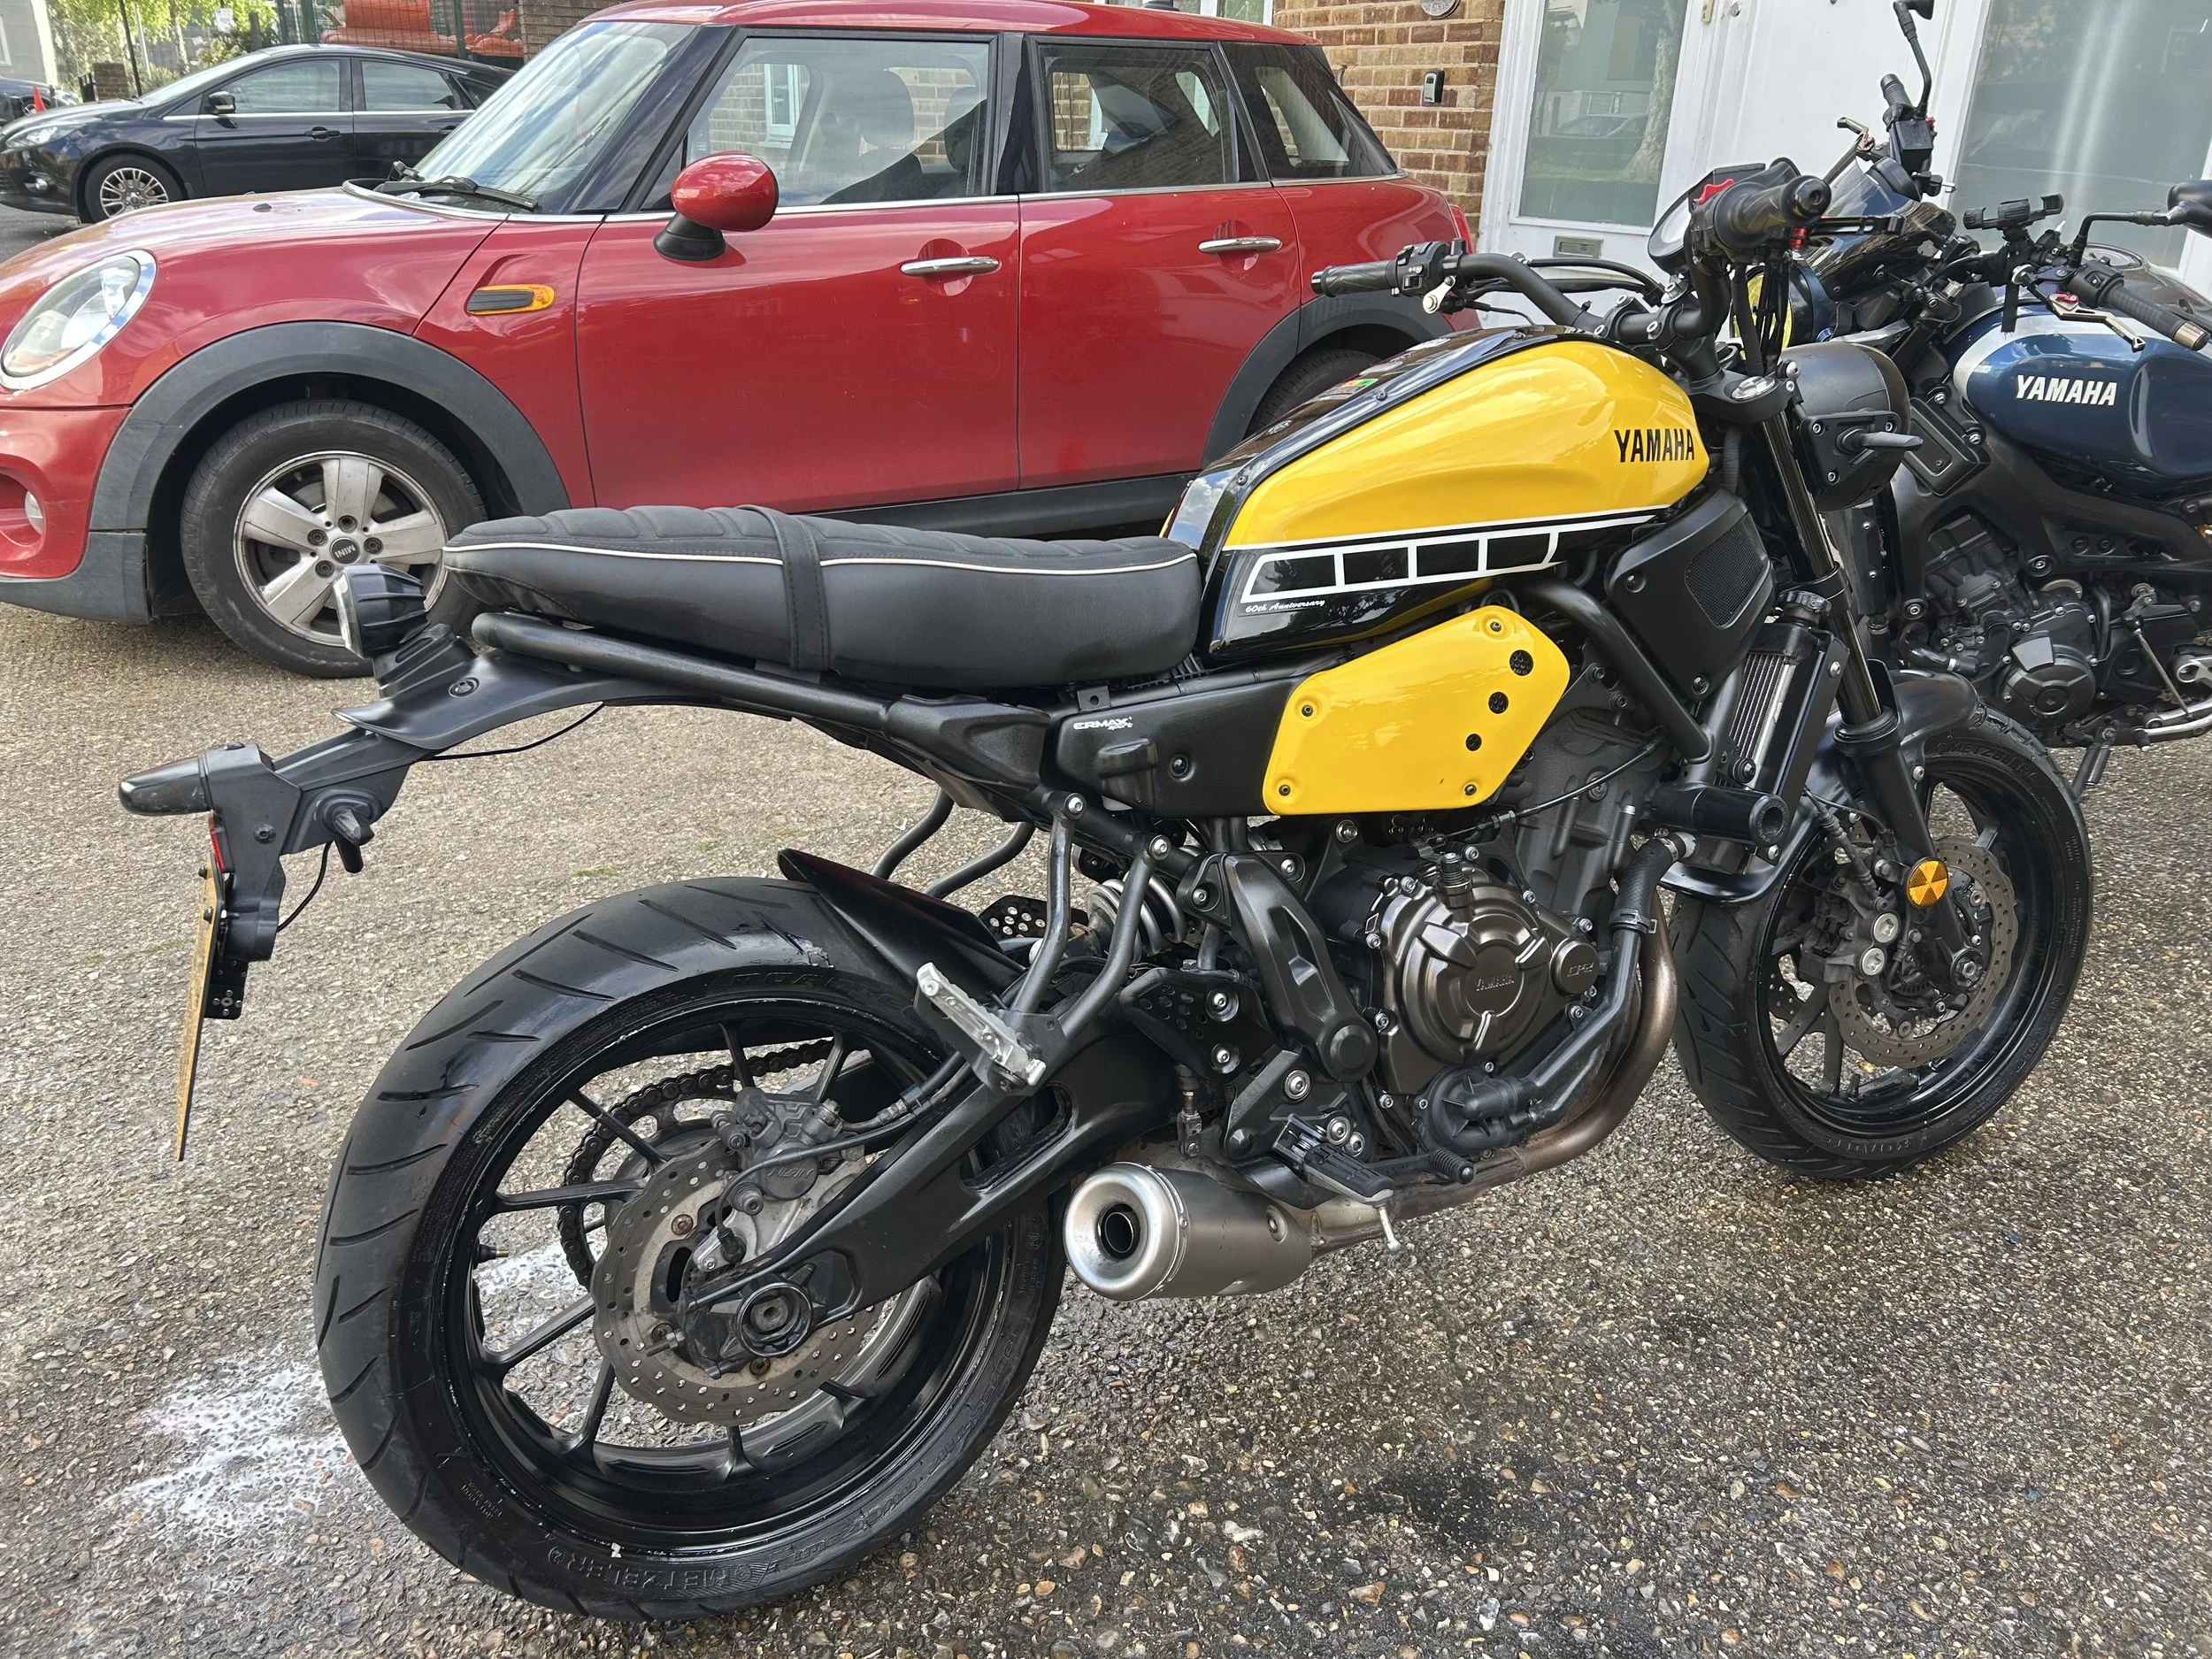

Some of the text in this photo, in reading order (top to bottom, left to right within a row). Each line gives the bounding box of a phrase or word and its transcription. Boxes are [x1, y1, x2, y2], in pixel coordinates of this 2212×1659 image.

[2016, 374, 2117, 406] YAMAHA
[1613, 428, 1695, 463] YAMAHA
[334, 544, 357, 559] MINI
[1245, 599, 1326, 613] 60th Anniversary
[1072, 718, 1128, 730] ERMAX
